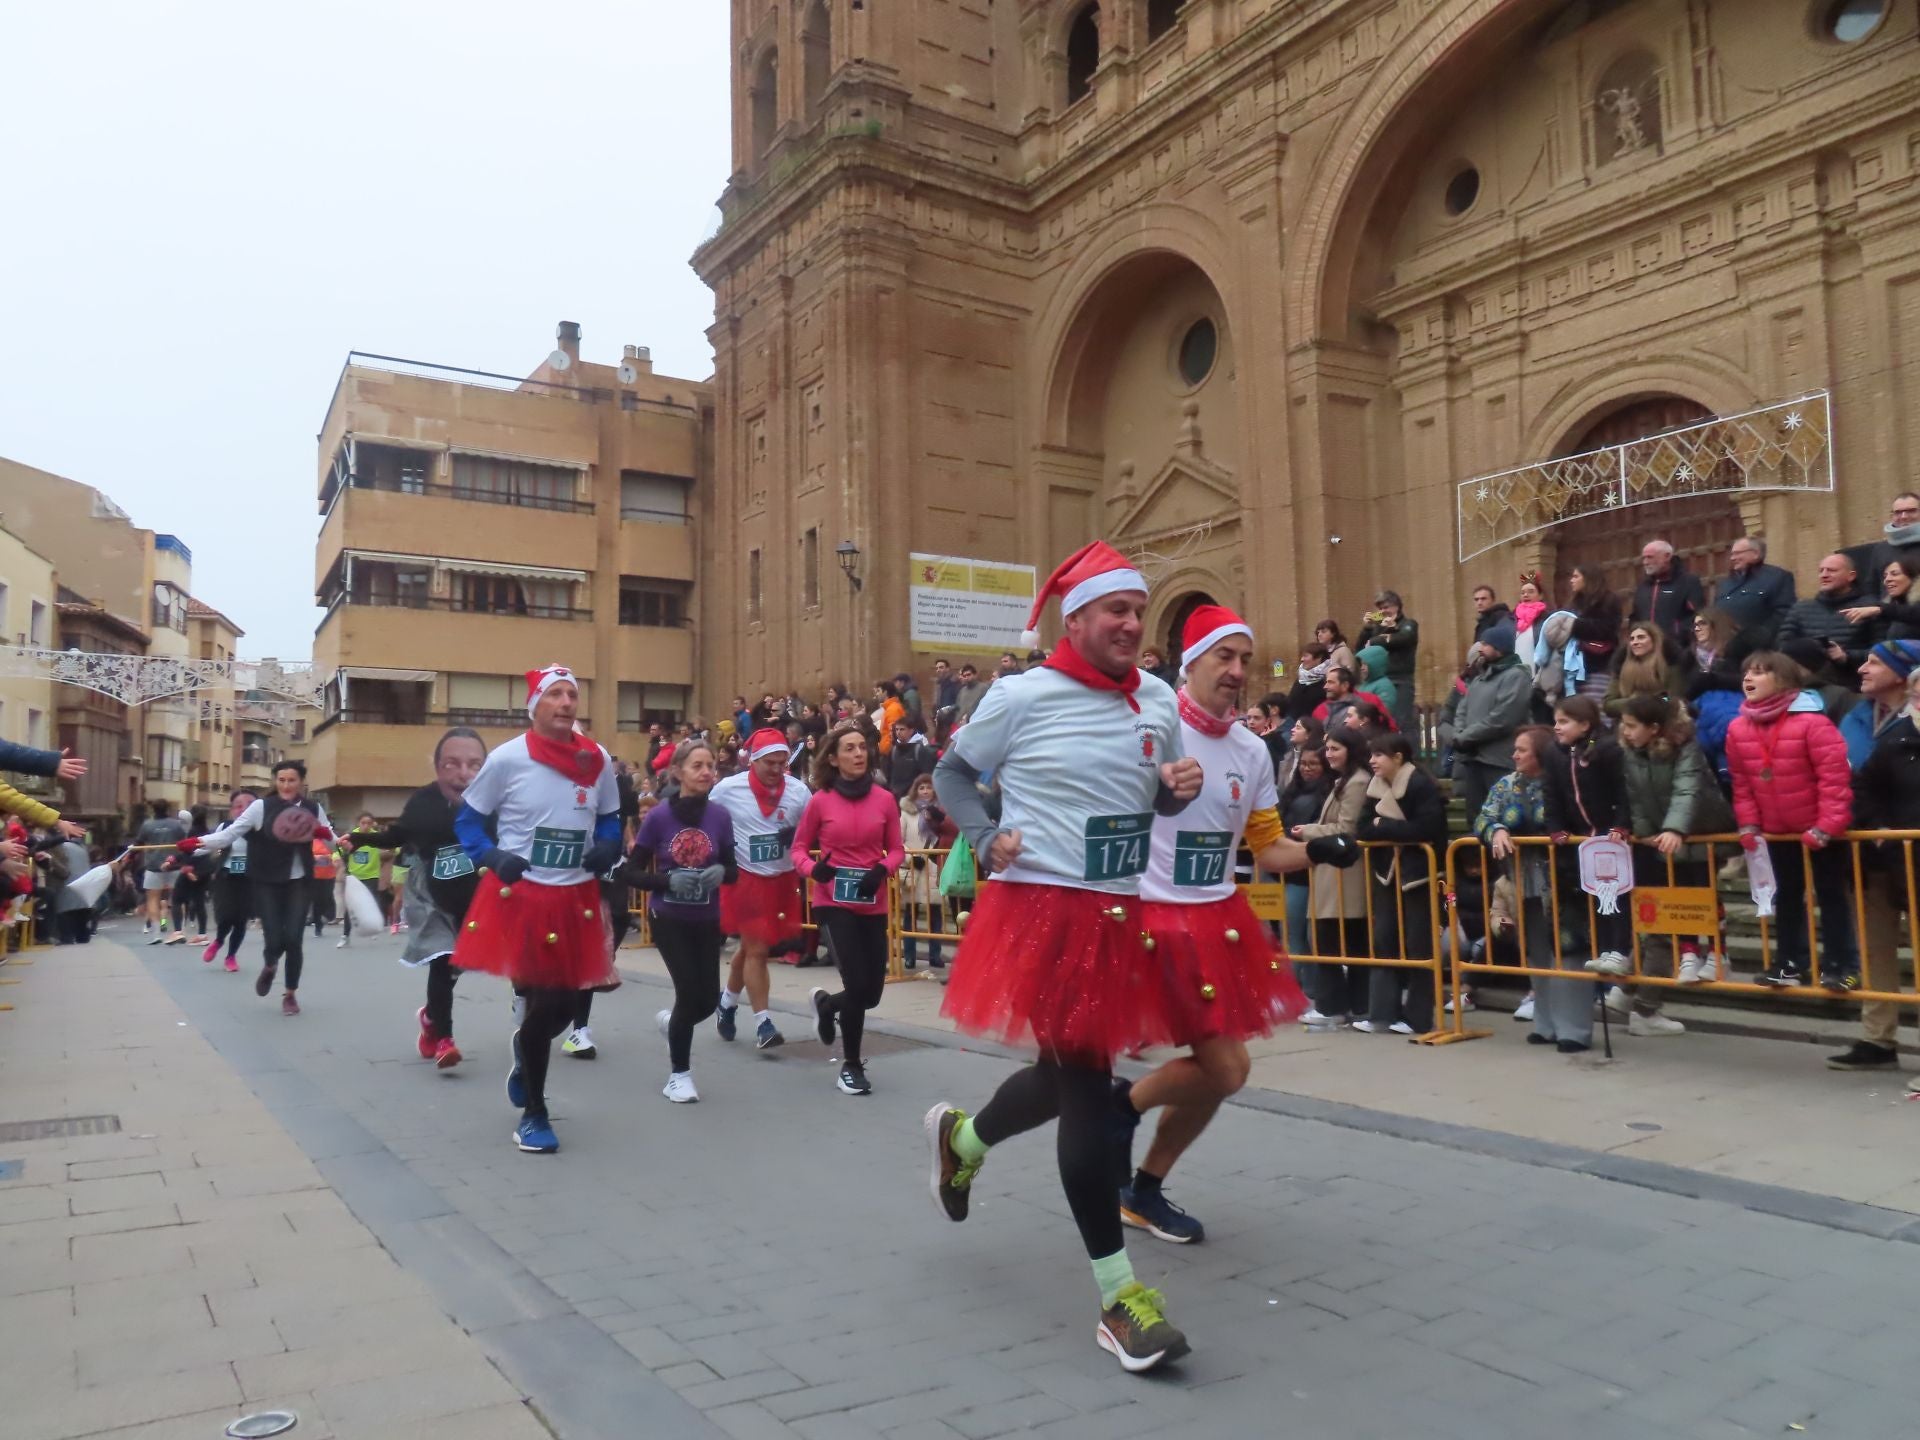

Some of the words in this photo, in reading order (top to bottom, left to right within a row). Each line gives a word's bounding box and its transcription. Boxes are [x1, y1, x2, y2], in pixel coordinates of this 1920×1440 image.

[543, 845, 575, 865] 171
[756, 844, 780, 860] 173
[1101, 838, 1141, 874] 174
[441, 858, 461, 876] 22
[1188, 853, 1222, 880] 172
